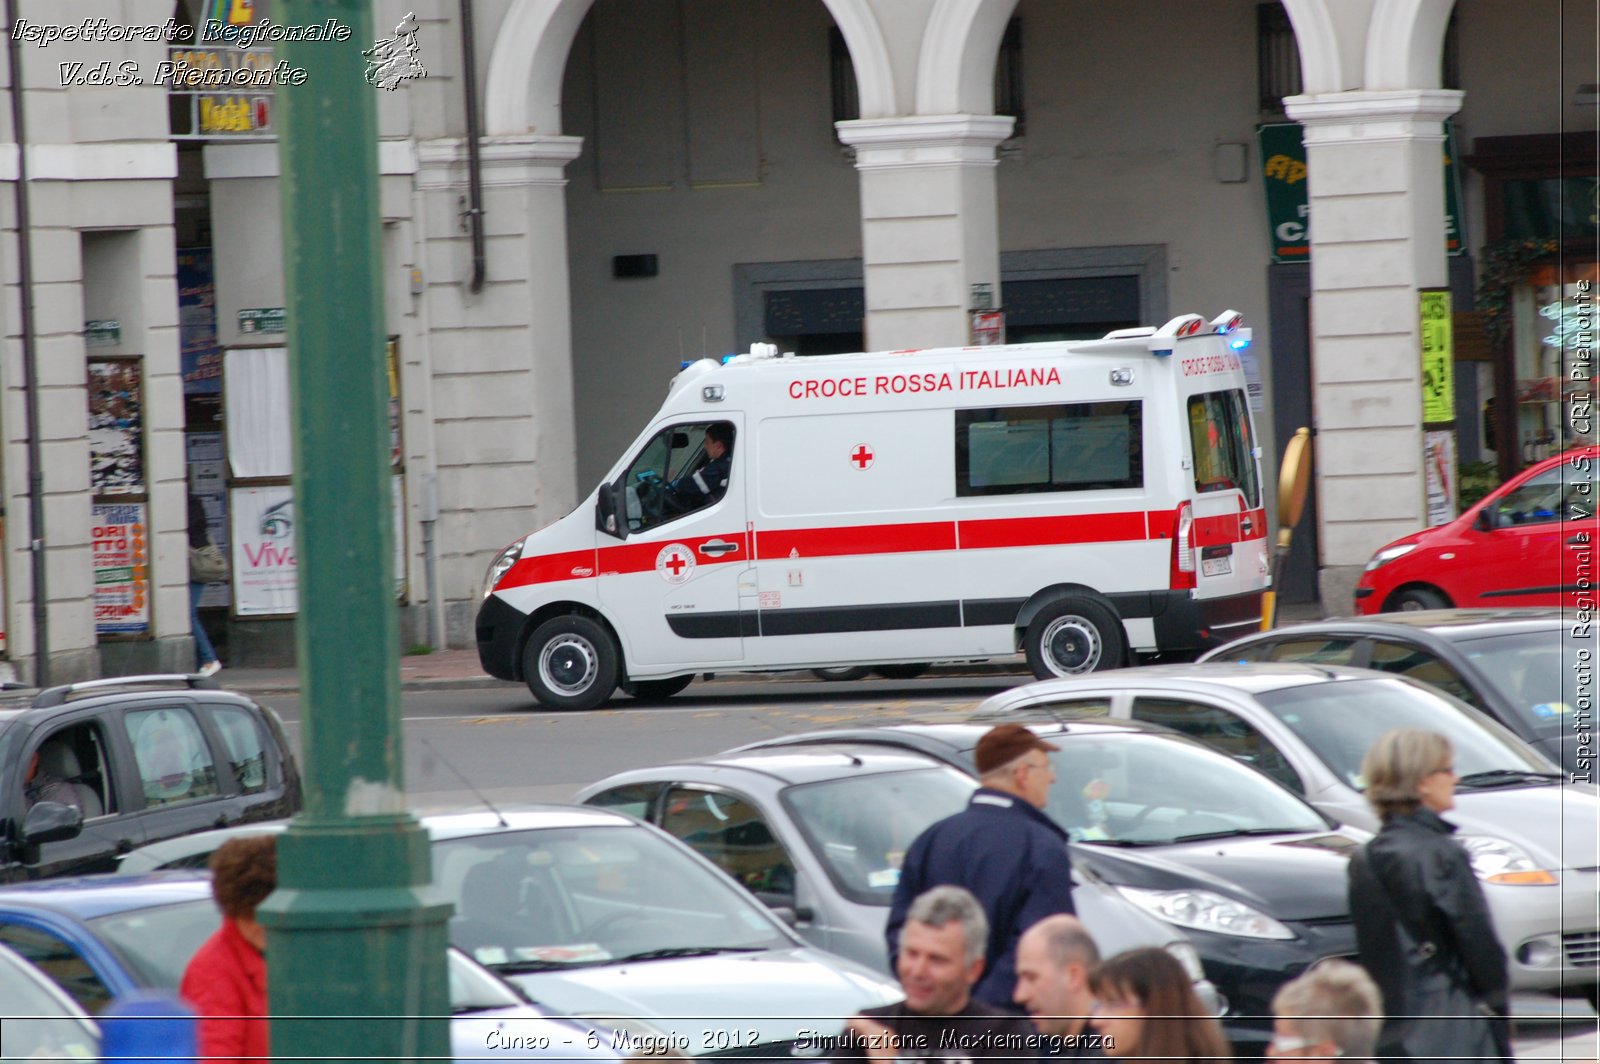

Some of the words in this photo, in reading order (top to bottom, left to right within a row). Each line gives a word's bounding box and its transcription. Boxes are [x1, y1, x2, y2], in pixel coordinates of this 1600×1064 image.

[1181, 358, 1206, 377] CROCE
[789, 377, 868, 399] CROCE
[875, 373, 953, 395] ROSSA
[959, 367, 1061, 390] ITALIANA
